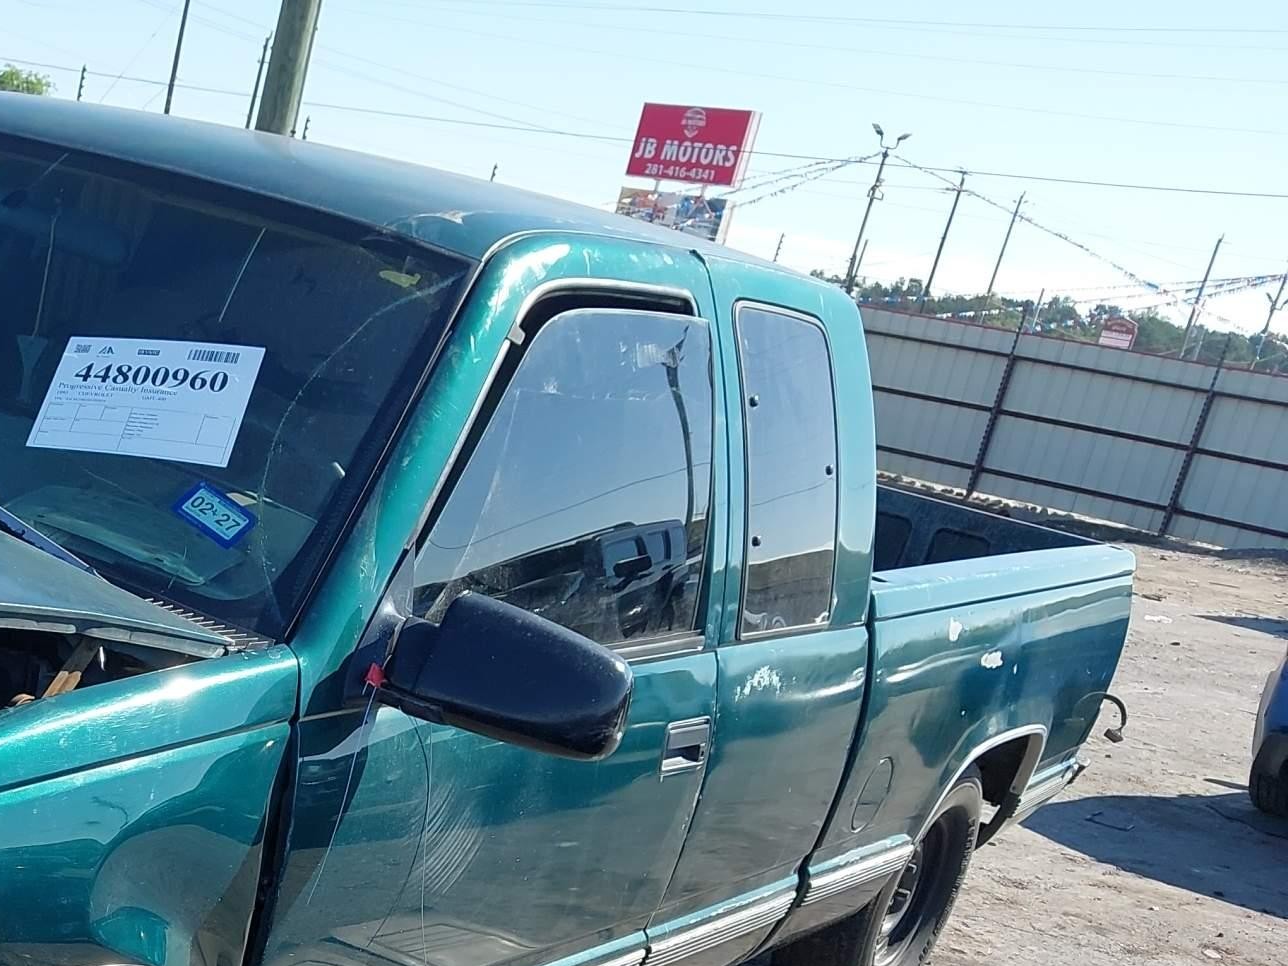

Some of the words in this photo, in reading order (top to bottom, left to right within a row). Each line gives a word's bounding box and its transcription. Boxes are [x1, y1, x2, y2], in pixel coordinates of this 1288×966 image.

[635, 138, 657, 158] JB
[661, 140, 737, 167] MOTORS
[645, 163, 715, 180] 281-416-4341
[74, 361, 229, 393] 44800960
[58, 382, 102, 391] Progressive
[105, 384, 137, 394] Casualty
[140, 386, 178, 397] Insurance
